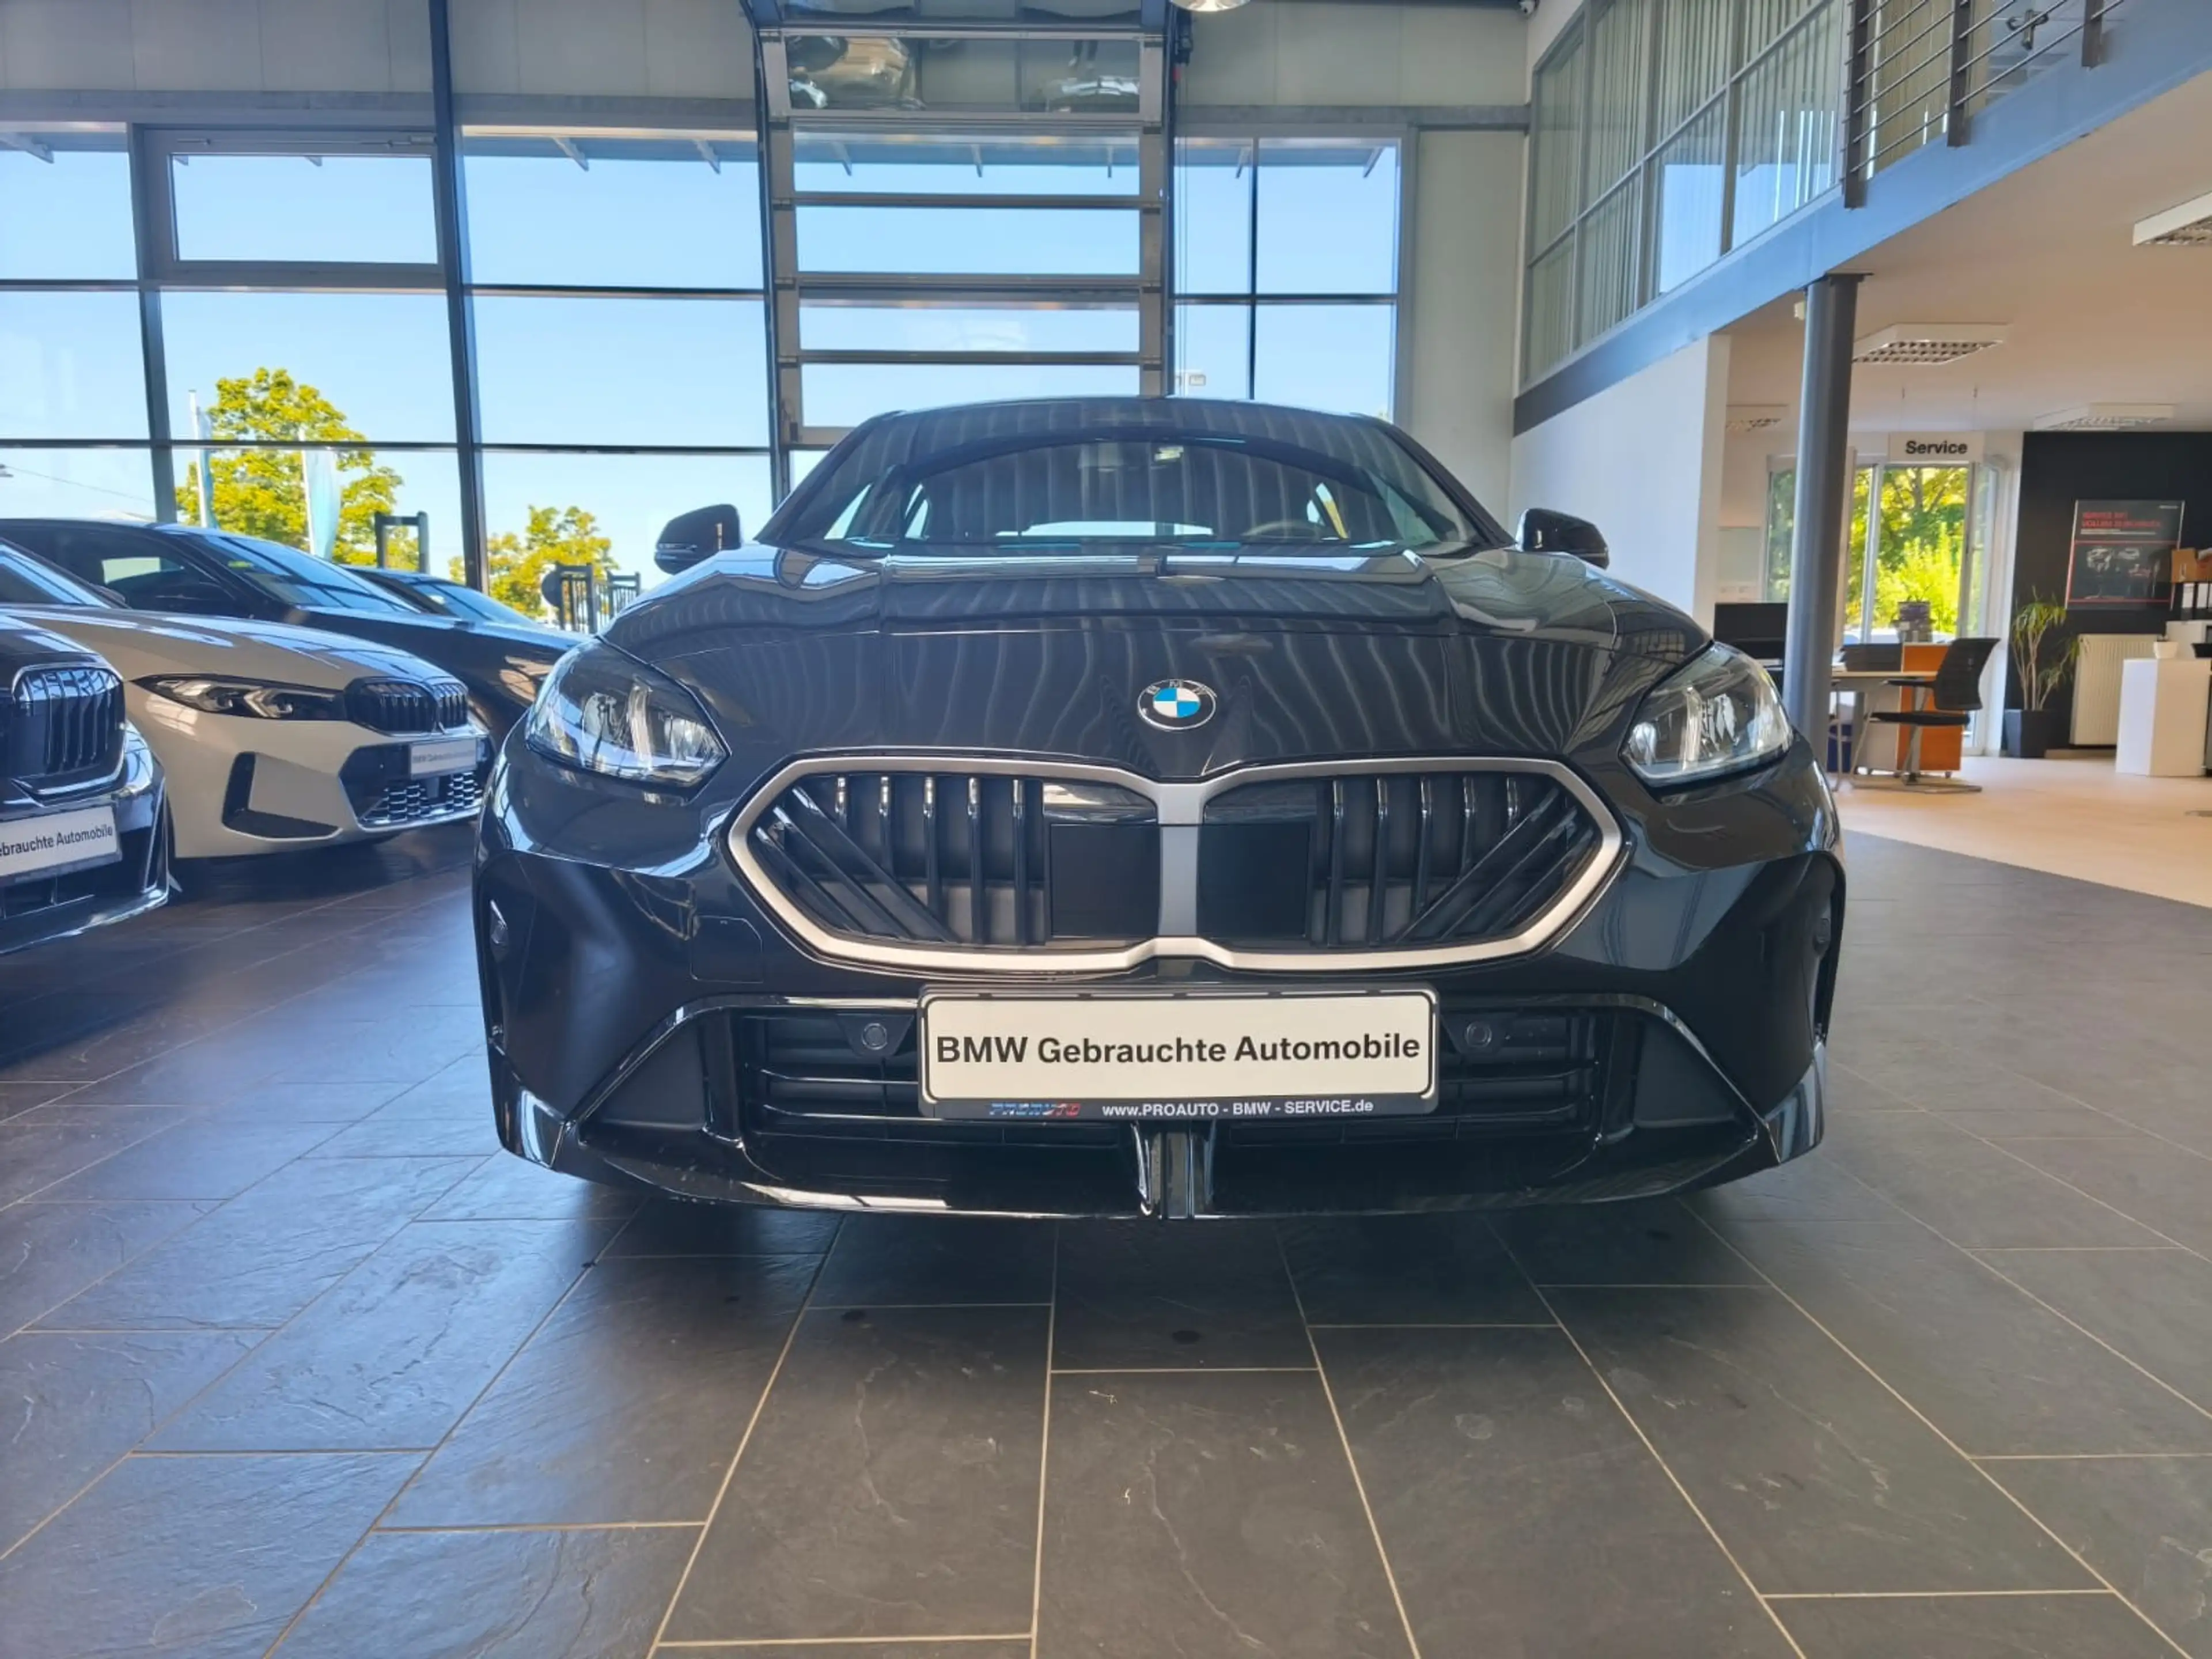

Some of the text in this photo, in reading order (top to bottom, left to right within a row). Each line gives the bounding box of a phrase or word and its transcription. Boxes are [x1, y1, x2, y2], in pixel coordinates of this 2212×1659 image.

[1906, 440, 1968, 454] Service
[56, 824, 113, 846] Automobile
[937, 1033, 1421, 1063] BMW Gebrauchte Automobile
[1102, 1103, 1219, 1116] www.PROAUTO
[1233, 1101, 1271, 1115] BMW
[1285, 1099, 1374, 1114] SERVICE.de
